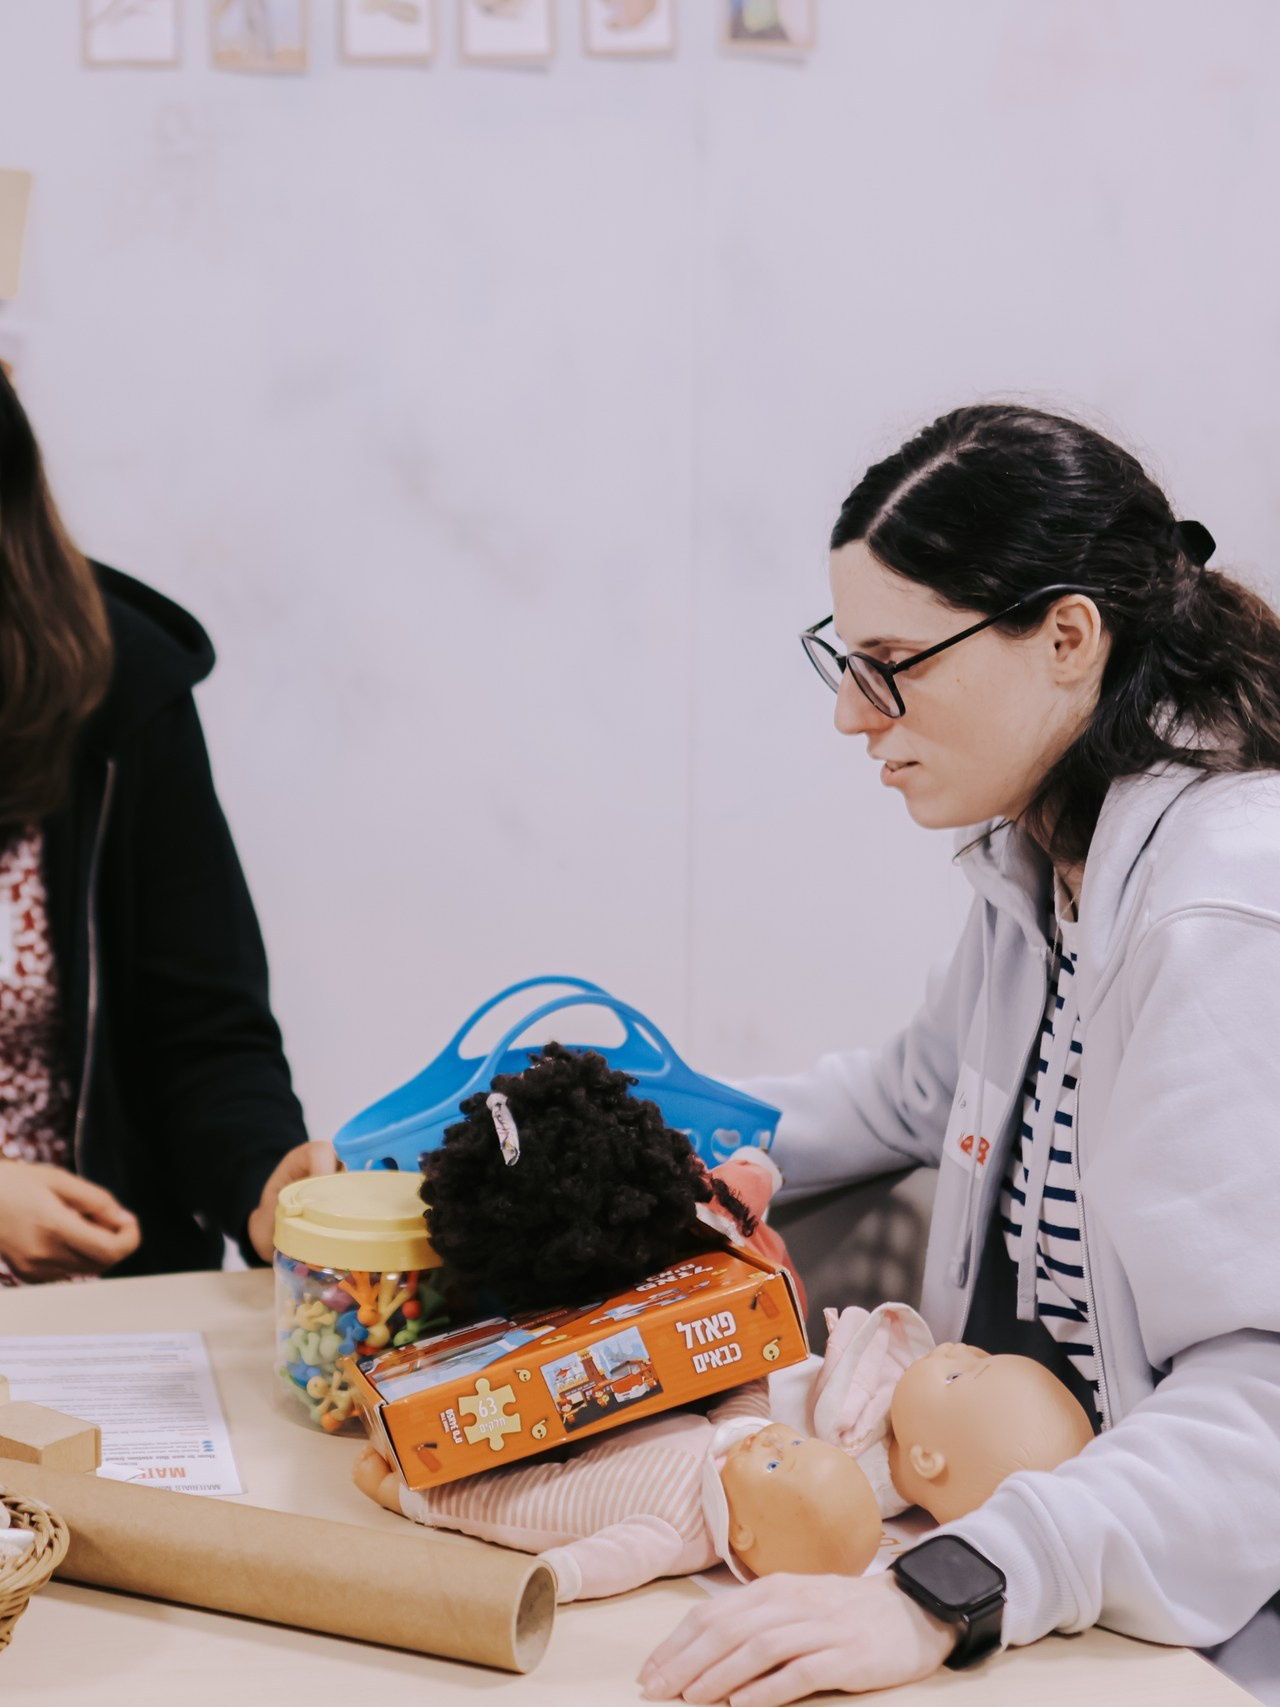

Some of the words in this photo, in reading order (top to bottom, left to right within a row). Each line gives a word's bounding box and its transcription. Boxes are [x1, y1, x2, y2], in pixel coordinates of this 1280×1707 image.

[675, 1311, 736, 1349] פאזל
[692, 1343, 742, 1374] כבאים
[479, 1397, 498, 1418] 63
[480, 1417, 507, 1434] חלקים
